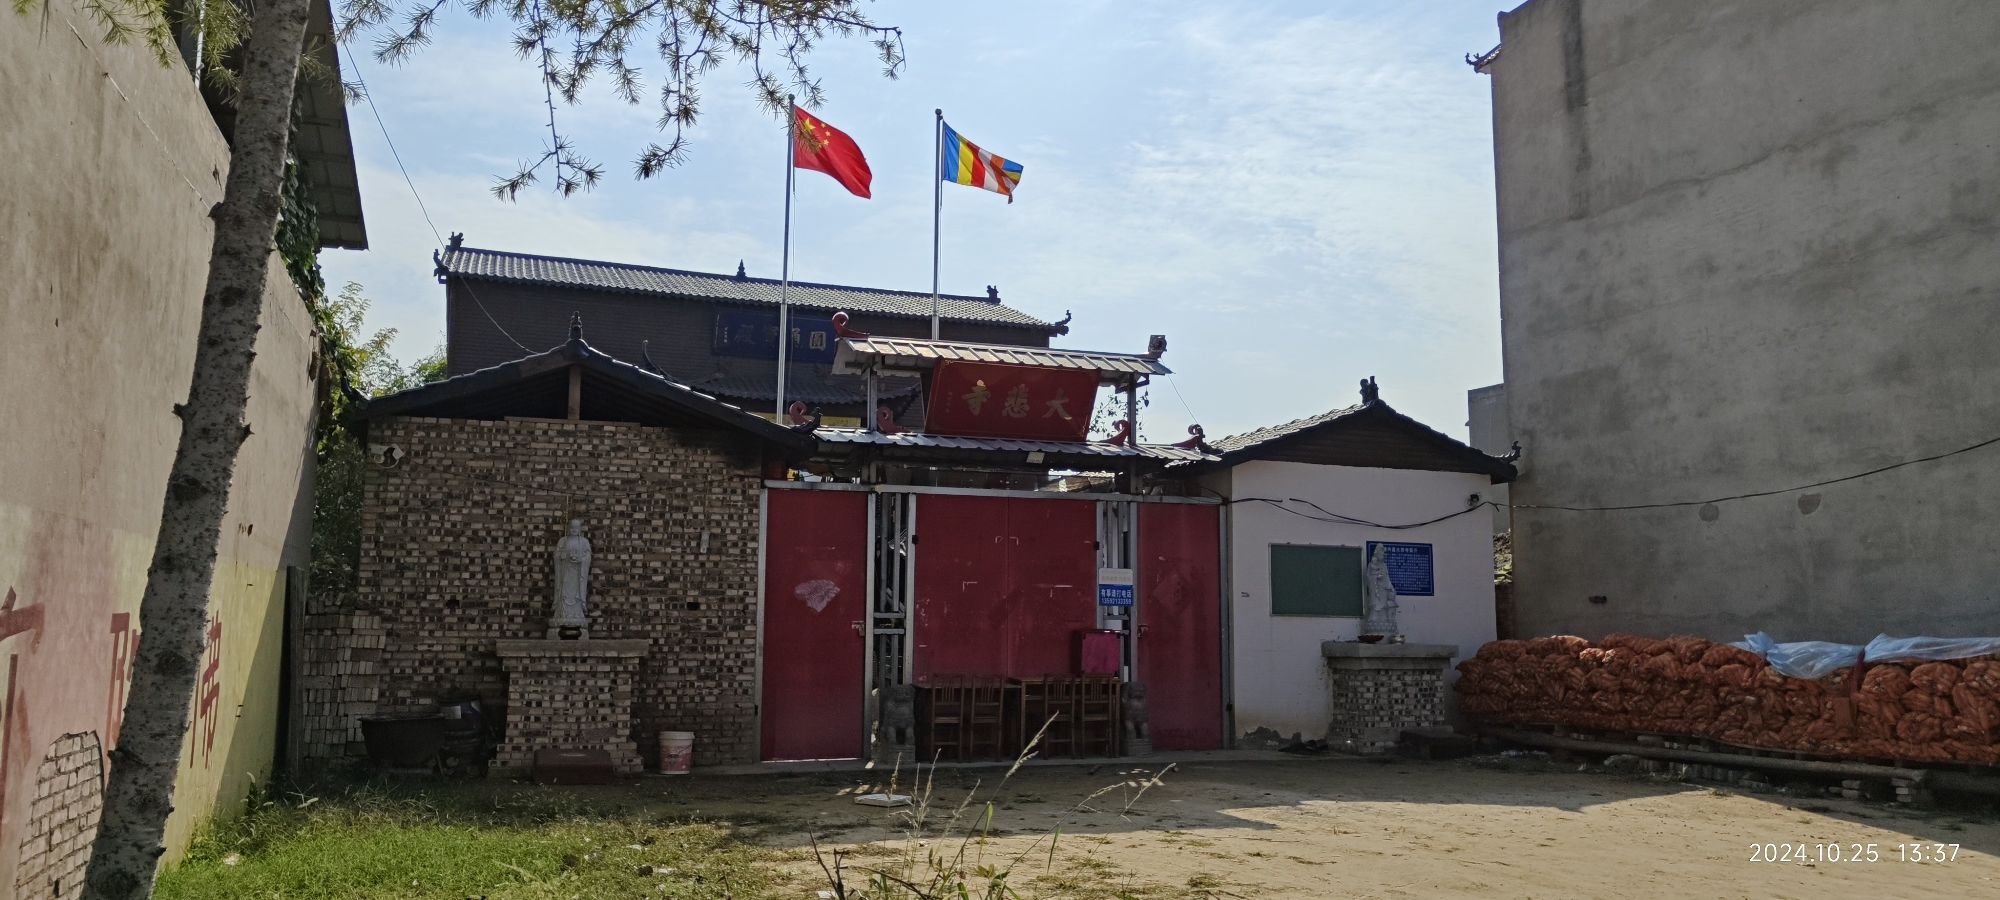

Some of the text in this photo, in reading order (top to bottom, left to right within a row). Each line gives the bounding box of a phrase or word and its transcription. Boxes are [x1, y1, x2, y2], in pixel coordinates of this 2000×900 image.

[961, 379, 1073, 421] 大悲寺
[1101, 588, 1132, 598] 有事请打电话
